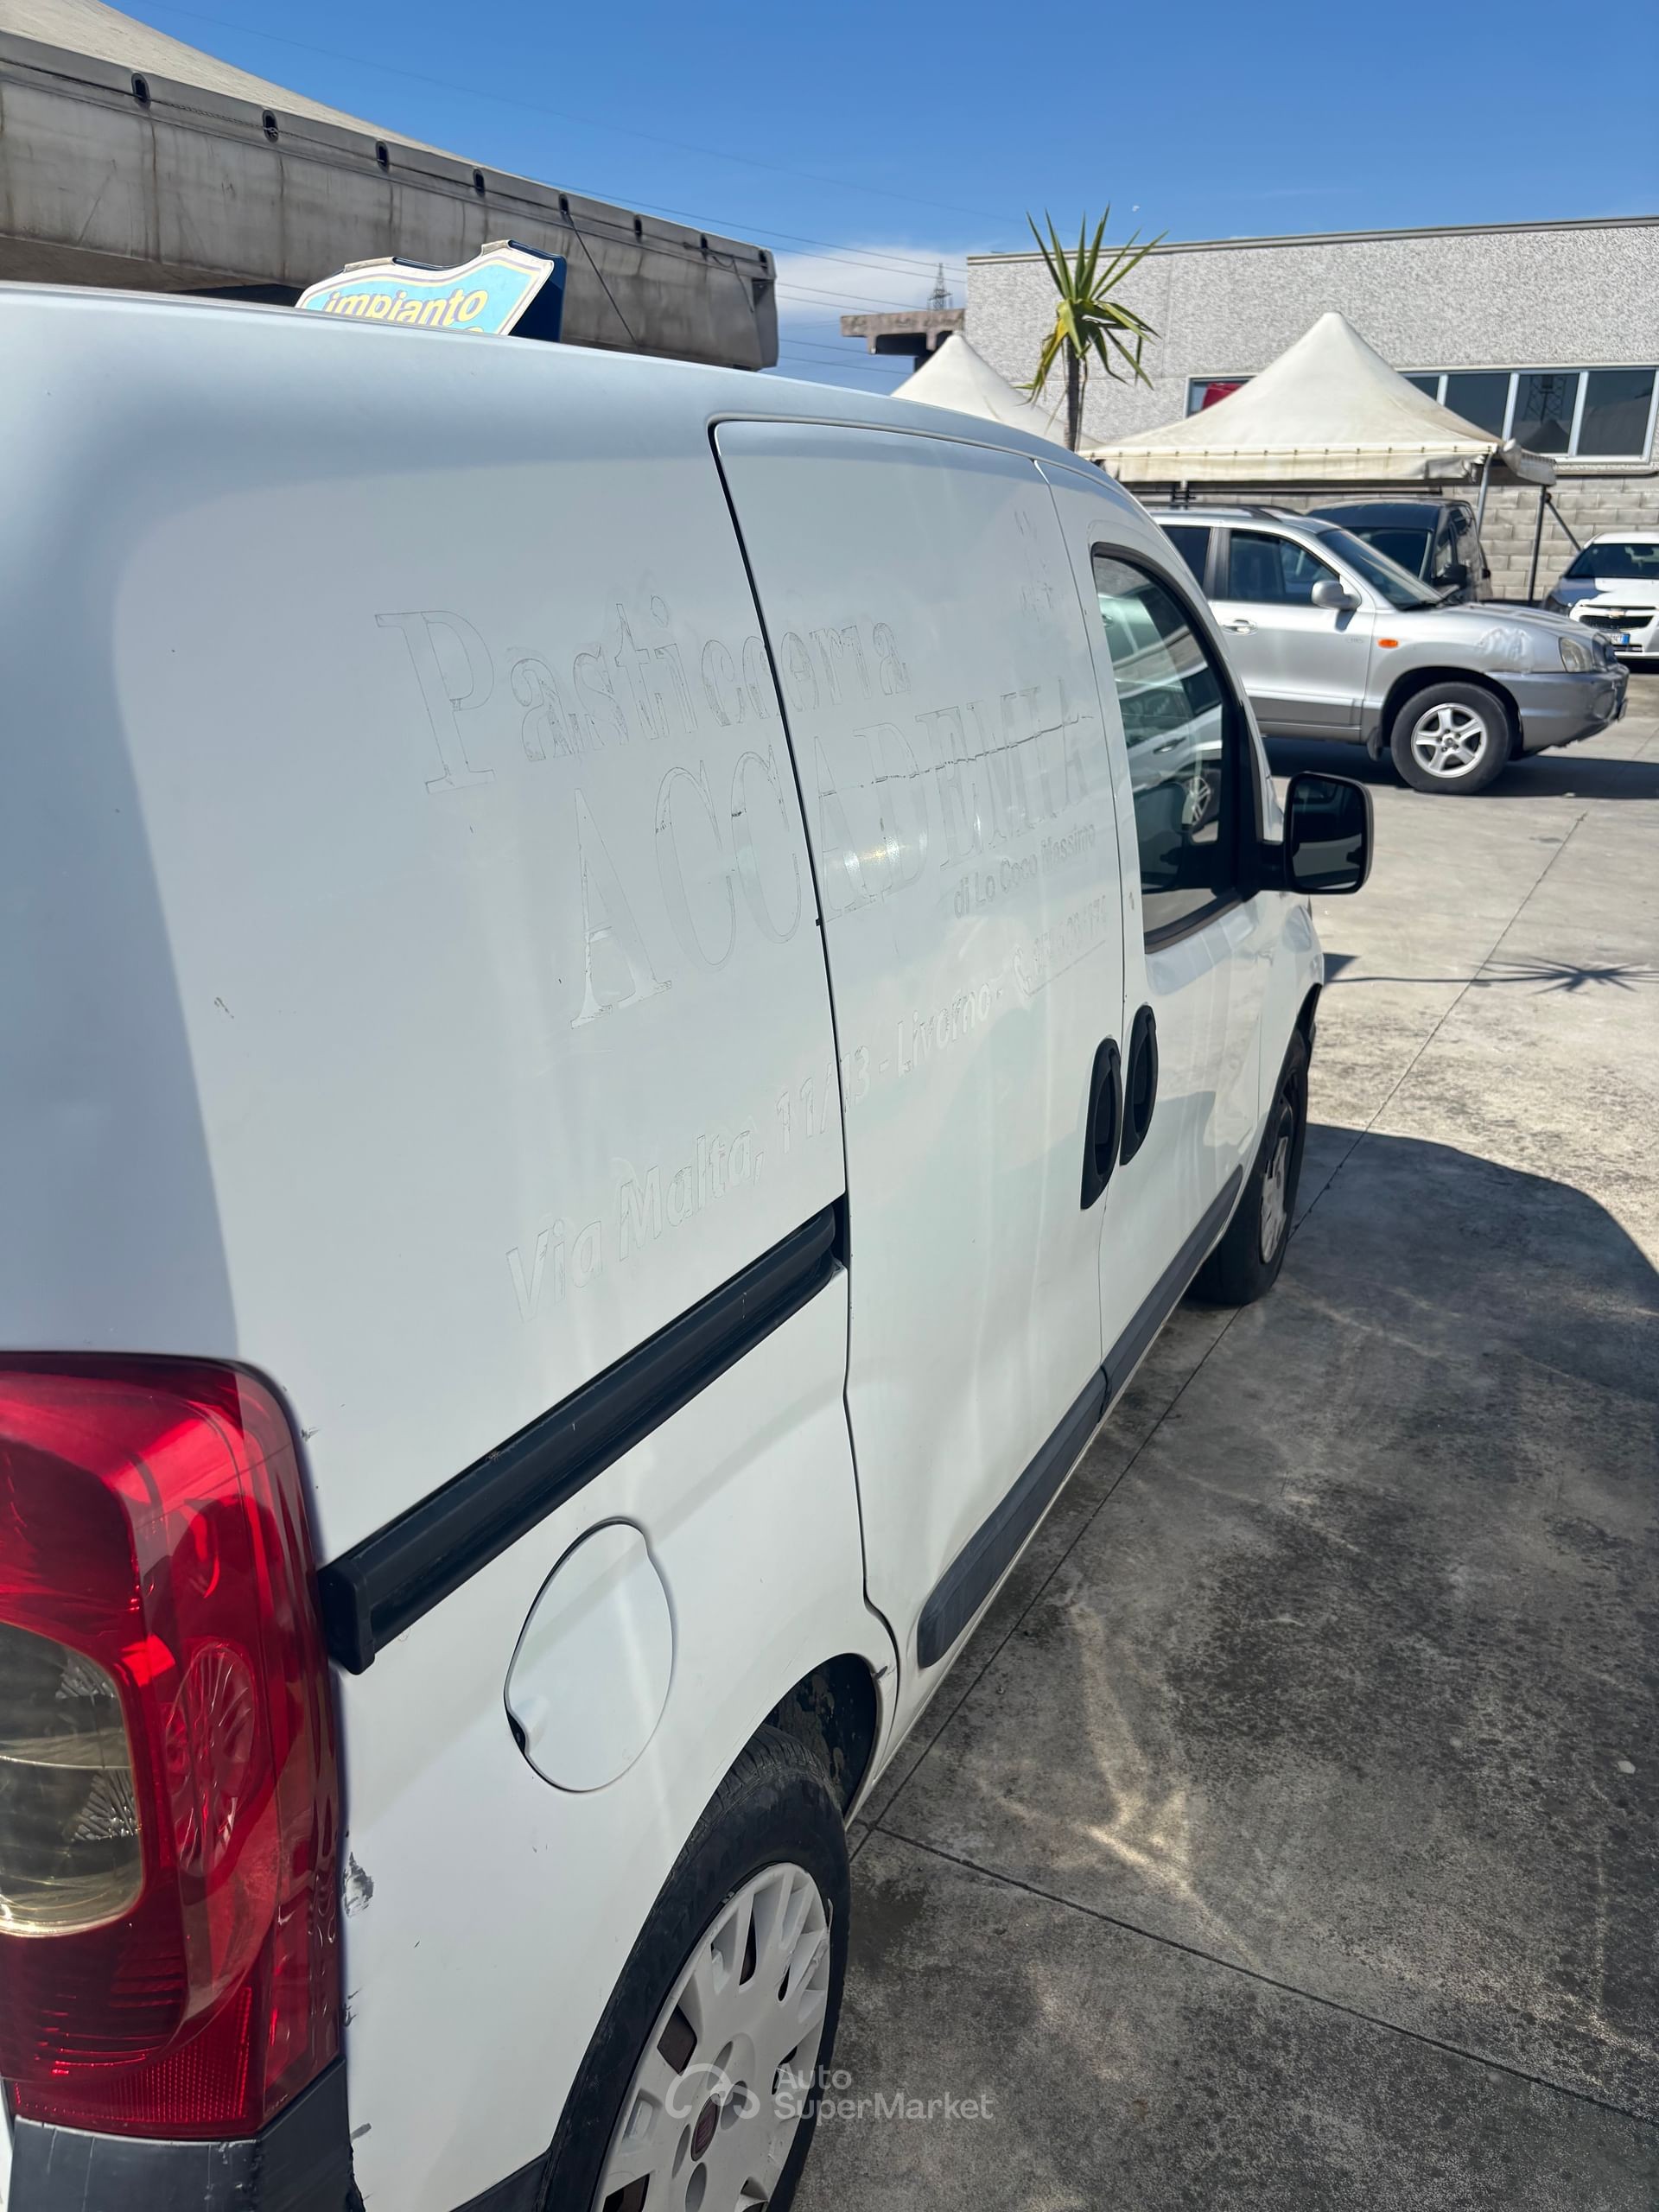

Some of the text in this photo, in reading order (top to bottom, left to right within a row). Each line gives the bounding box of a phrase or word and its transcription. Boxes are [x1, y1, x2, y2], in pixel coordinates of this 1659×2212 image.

[326, 288, 489, 327] impianto
[374, 594, 912, 793] Pasticceria
[568, 673, 1090, 1030] ACCADEMIA
[505, 1217, 604, 1324] Via
[618, 1128, 766, 1262] Malta,
[897, 982, 992, 1078] Livorno
